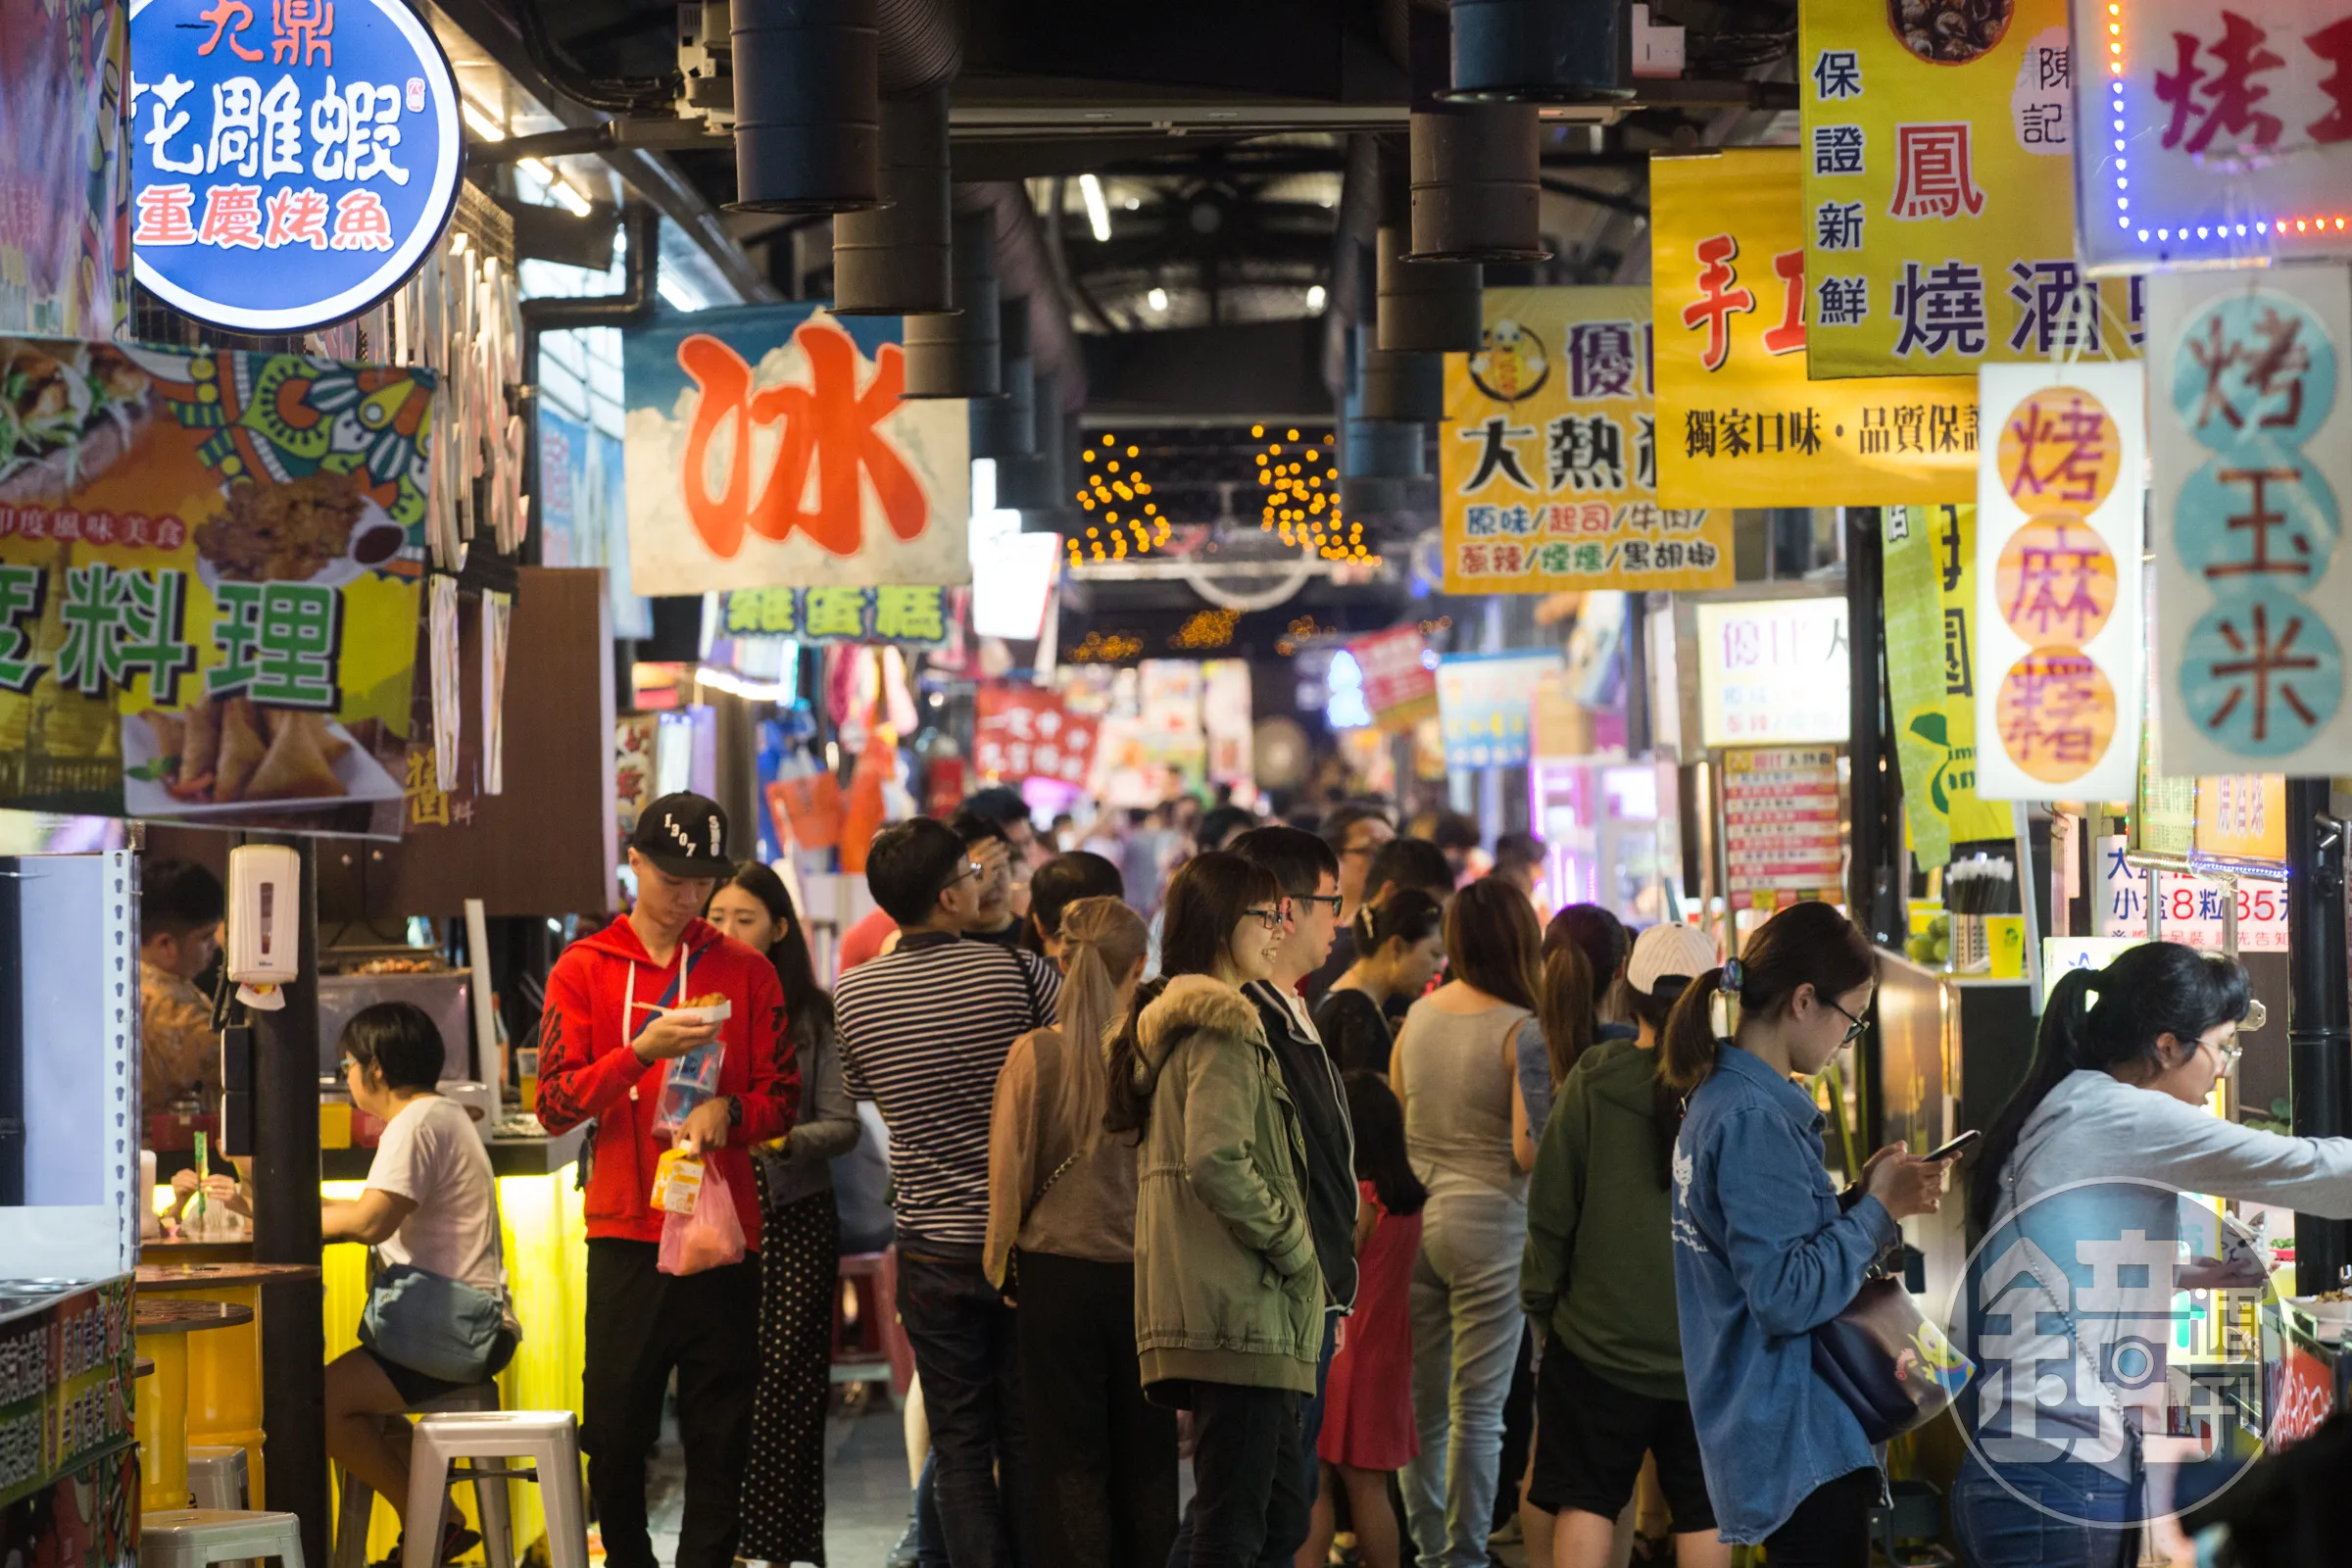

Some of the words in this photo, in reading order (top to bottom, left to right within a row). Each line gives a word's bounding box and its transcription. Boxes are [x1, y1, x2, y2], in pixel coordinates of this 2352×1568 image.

[198, 0, 332, 67] 九鼎
[130, 71, 410, 186] 花雕蝦
[1889, 122, 1985, 219] 鳳
[132, 182, 394, 251] 重慶烤魚
[1814, 50, 1866, 326] 保證新鮮
[1894, 261, 2146, 355] 燒酒
[1569, 322, 1654, 398] 優
[676, 322, 930, 564] 冰
[2187, 306, 2321, 743] 烤玉米
